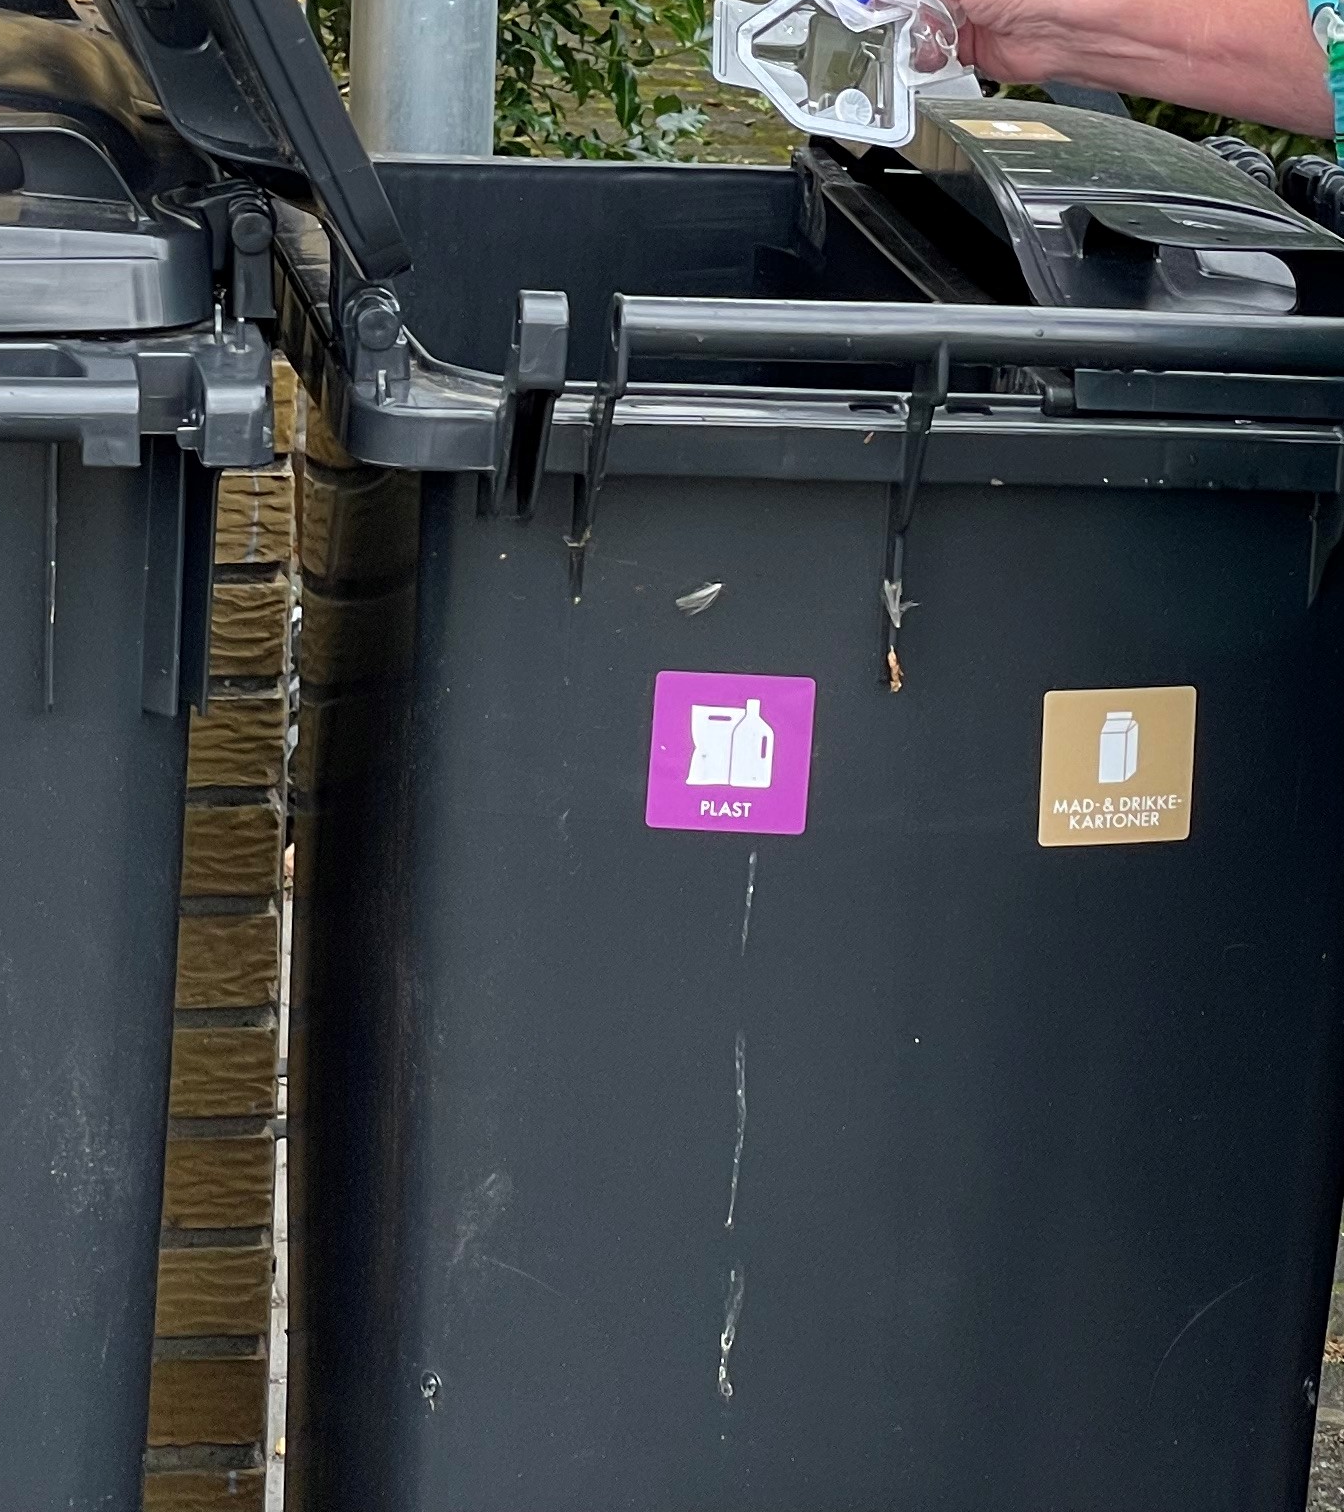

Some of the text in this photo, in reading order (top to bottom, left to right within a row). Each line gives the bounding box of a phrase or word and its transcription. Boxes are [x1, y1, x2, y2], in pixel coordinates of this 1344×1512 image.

[700, 800, 752, 818] PLAST
[1119, 794, 1183, 811] DRIKKE-
[1069, 811, 1160, 830] KARTONER
